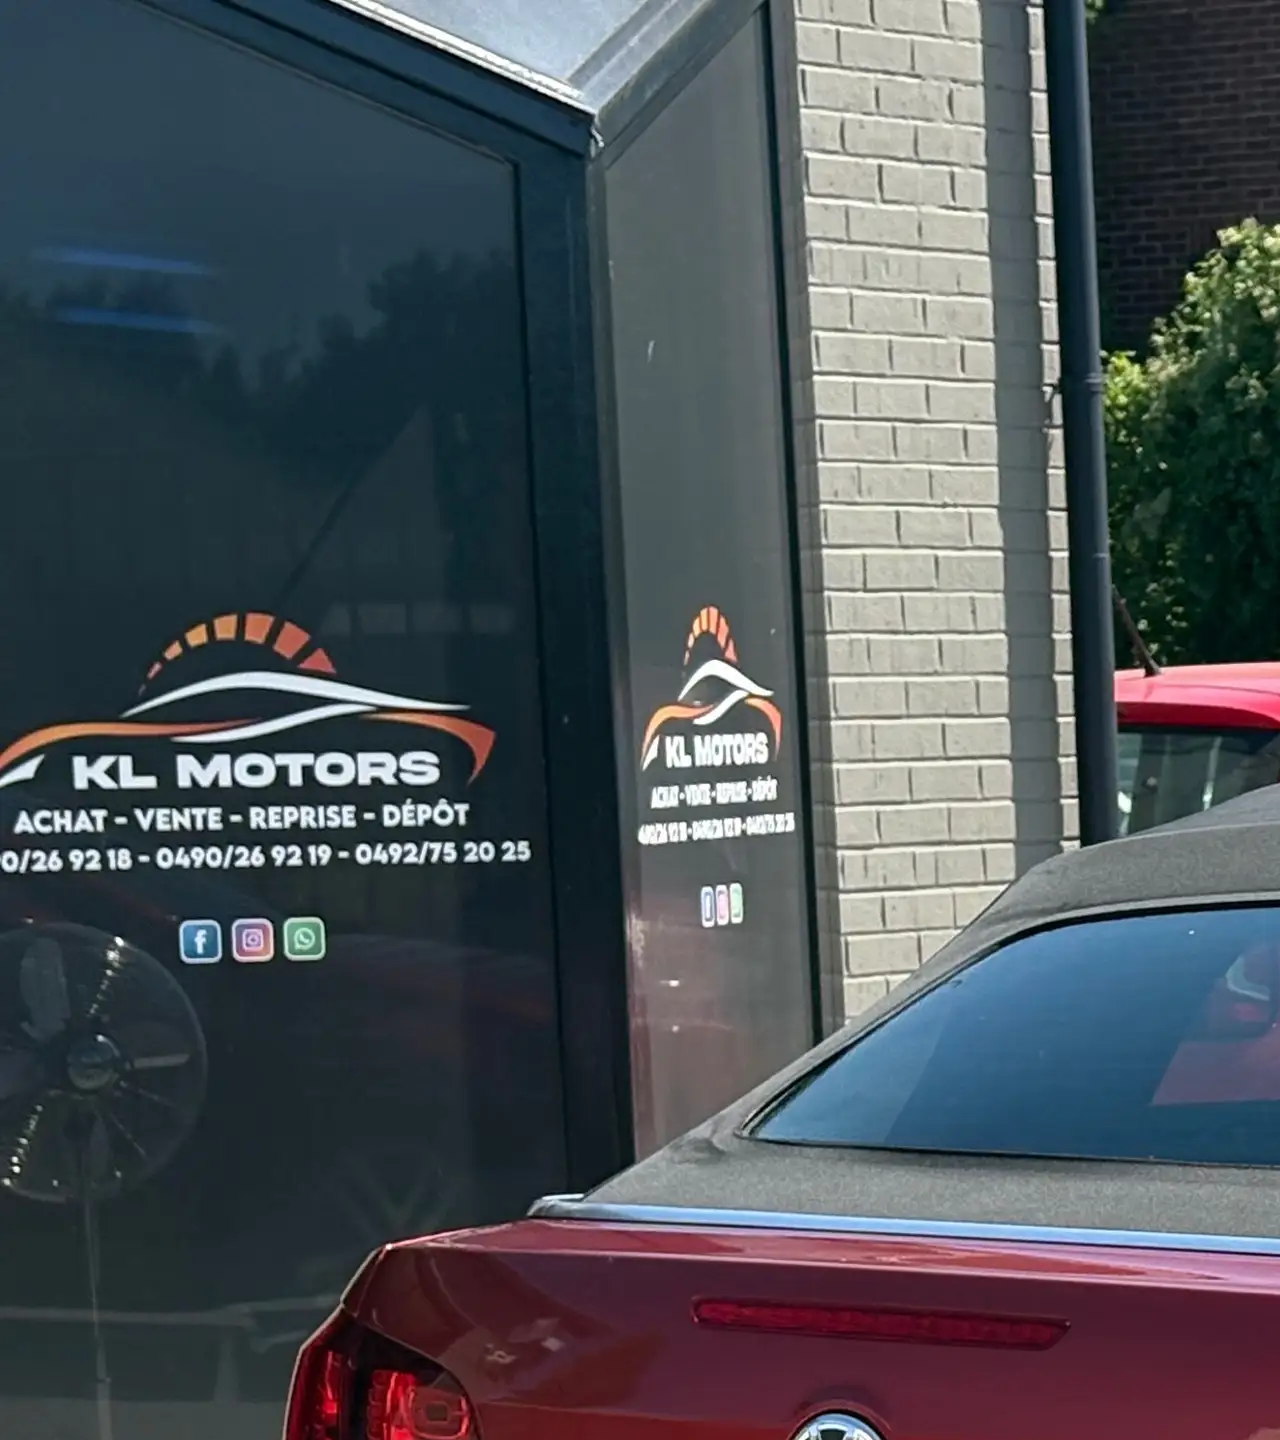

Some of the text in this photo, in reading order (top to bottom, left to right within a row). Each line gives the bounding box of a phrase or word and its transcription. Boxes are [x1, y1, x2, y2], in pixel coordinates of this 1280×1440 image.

[665, 731, 769, 769] KL MOTORS
[72, 750, 441, 790] KL MOTORS
[14, 808, 108, 834] ACHAT
[133, 806, 223, 832] VENTE
[249, 803, 357, 830] REPRISE
[382, 798, 470, 828] DÉPÔT
[0, 849, 64, 874] 0/26
[69, 849, 102, 871] 92
[107, 848, 133, 870] 18
[156, 845, 266, 869] 0490/26
[271, 844, 303, 867] 92
[307, 844, 332, 867] 19
[355, 841, 458, 866] 0492/75
[463, 842, 496, 863] 20
[501, 840, 532, 863] 25
